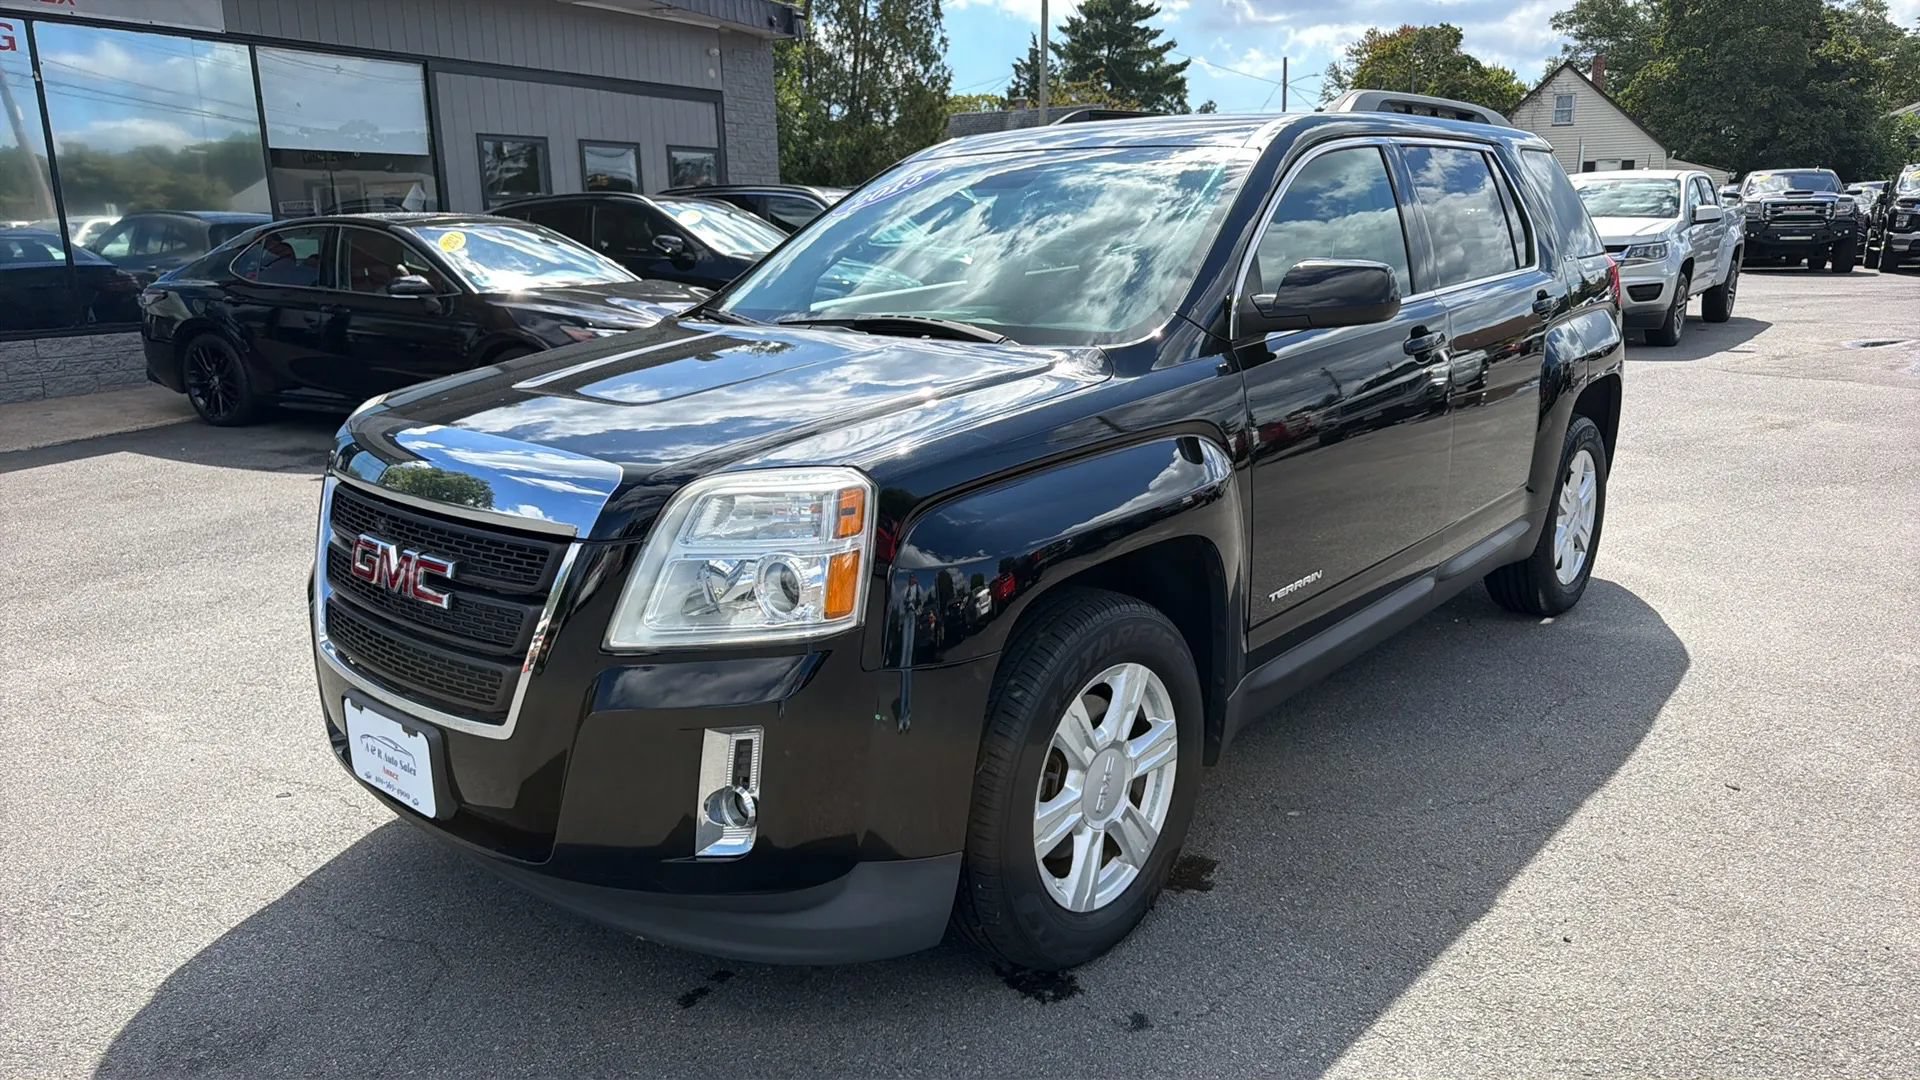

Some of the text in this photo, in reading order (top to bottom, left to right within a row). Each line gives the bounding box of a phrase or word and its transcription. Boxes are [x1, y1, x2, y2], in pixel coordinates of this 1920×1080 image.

[352, 533, 456, 610] GMC
[1268, 569, 1323, 602] TERRAIN
[384, 752, 398, 768] Auto
[400, 760, 416, 776] Sales
